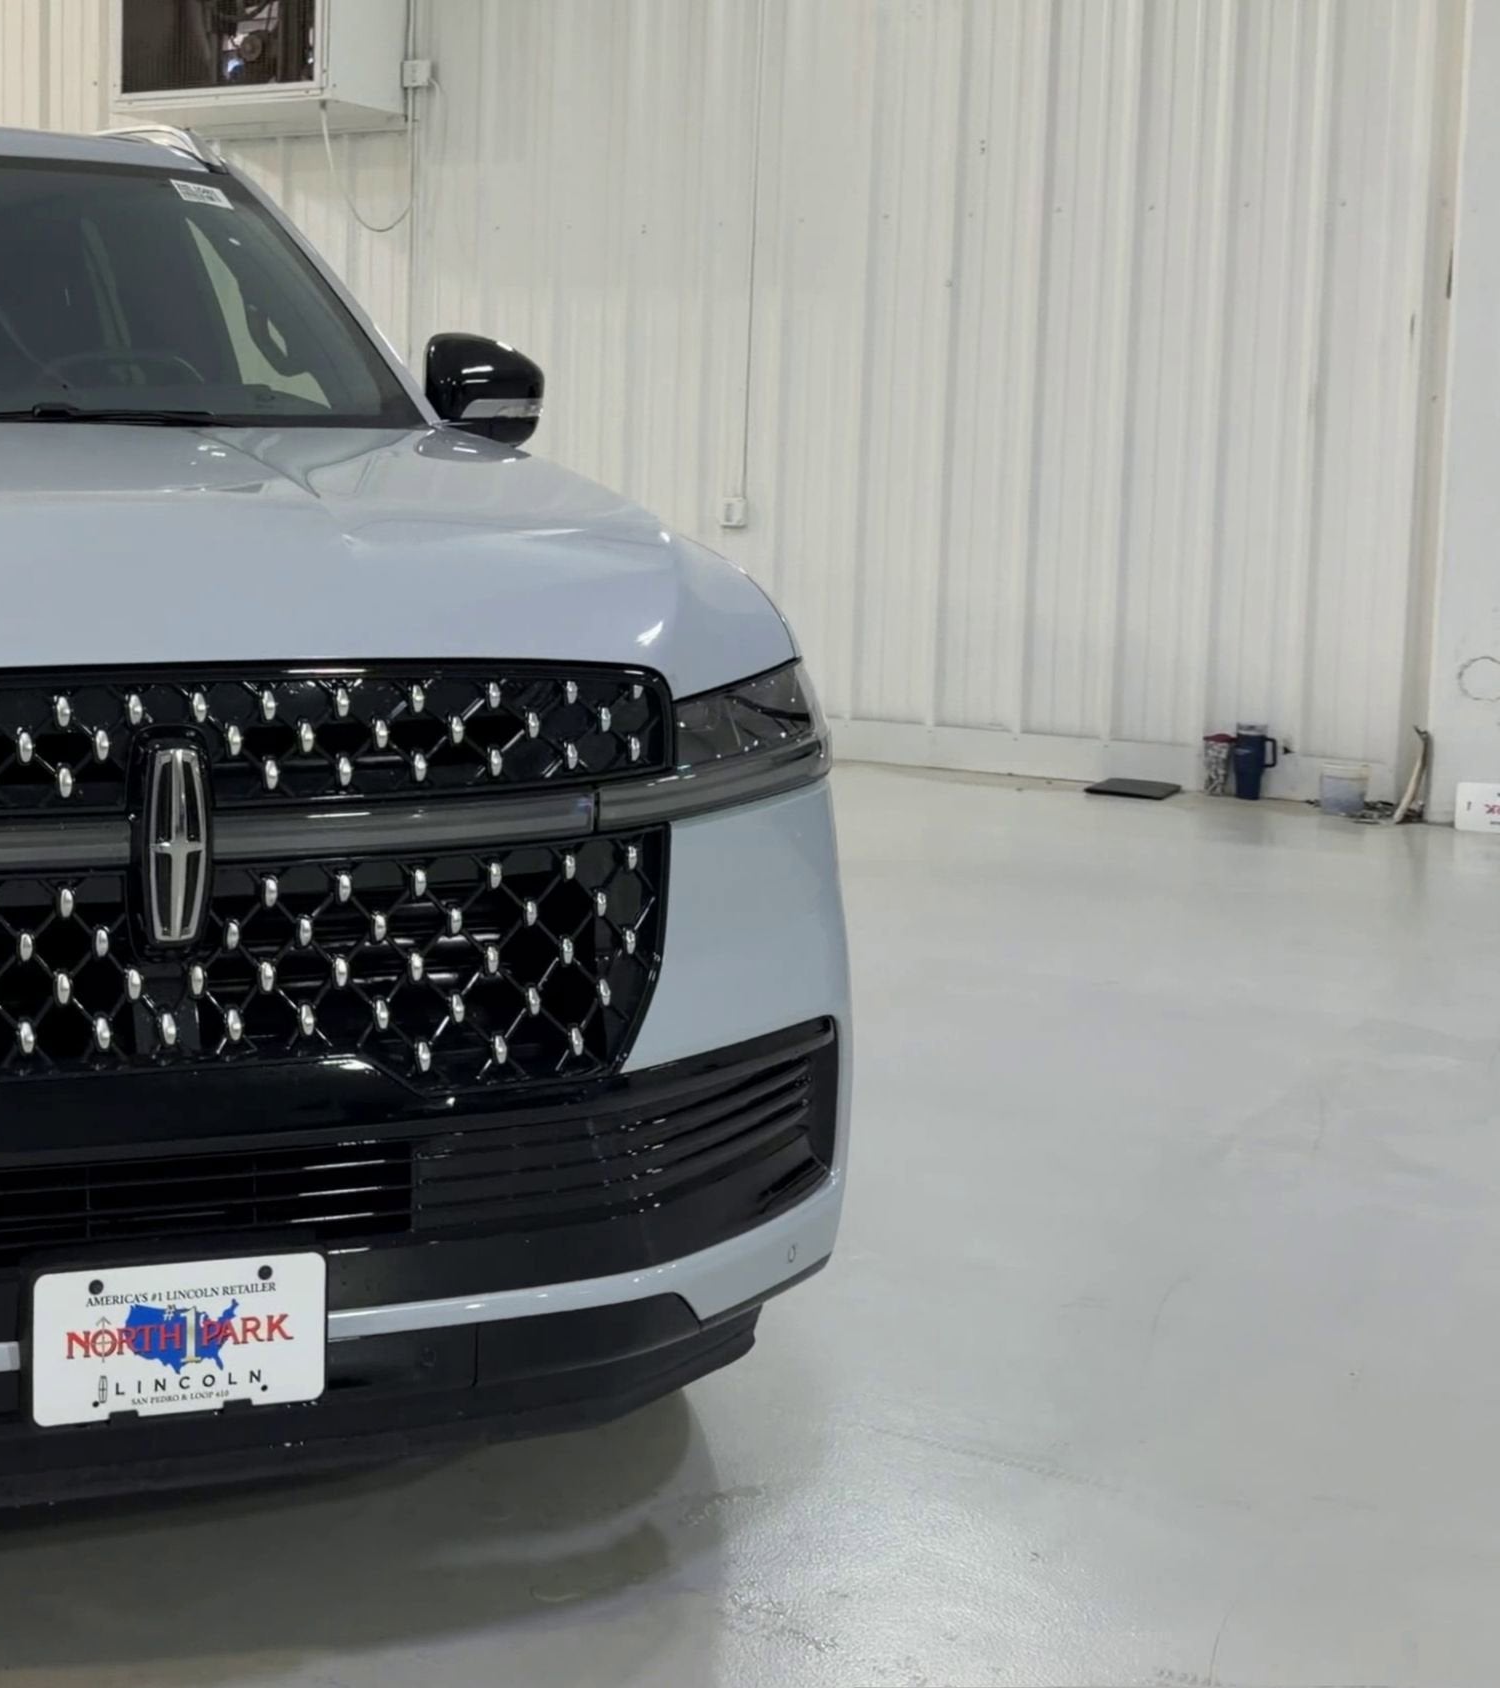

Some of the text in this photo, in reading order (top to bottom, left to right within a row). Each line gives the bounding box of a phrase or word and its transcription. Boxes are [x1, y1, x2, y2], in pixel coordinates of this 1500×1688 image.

[86, 1281, 277, 1308] AMERICA'S #1 LINCOLN RETAILER
[66, 1313, 294, 1360] NORTH PARK
[115, 1369, 262, 1396] LINCOLN
[131, 1397, 151, 1406] SAN
[151, 1394, 180, 1404] PEDRO
